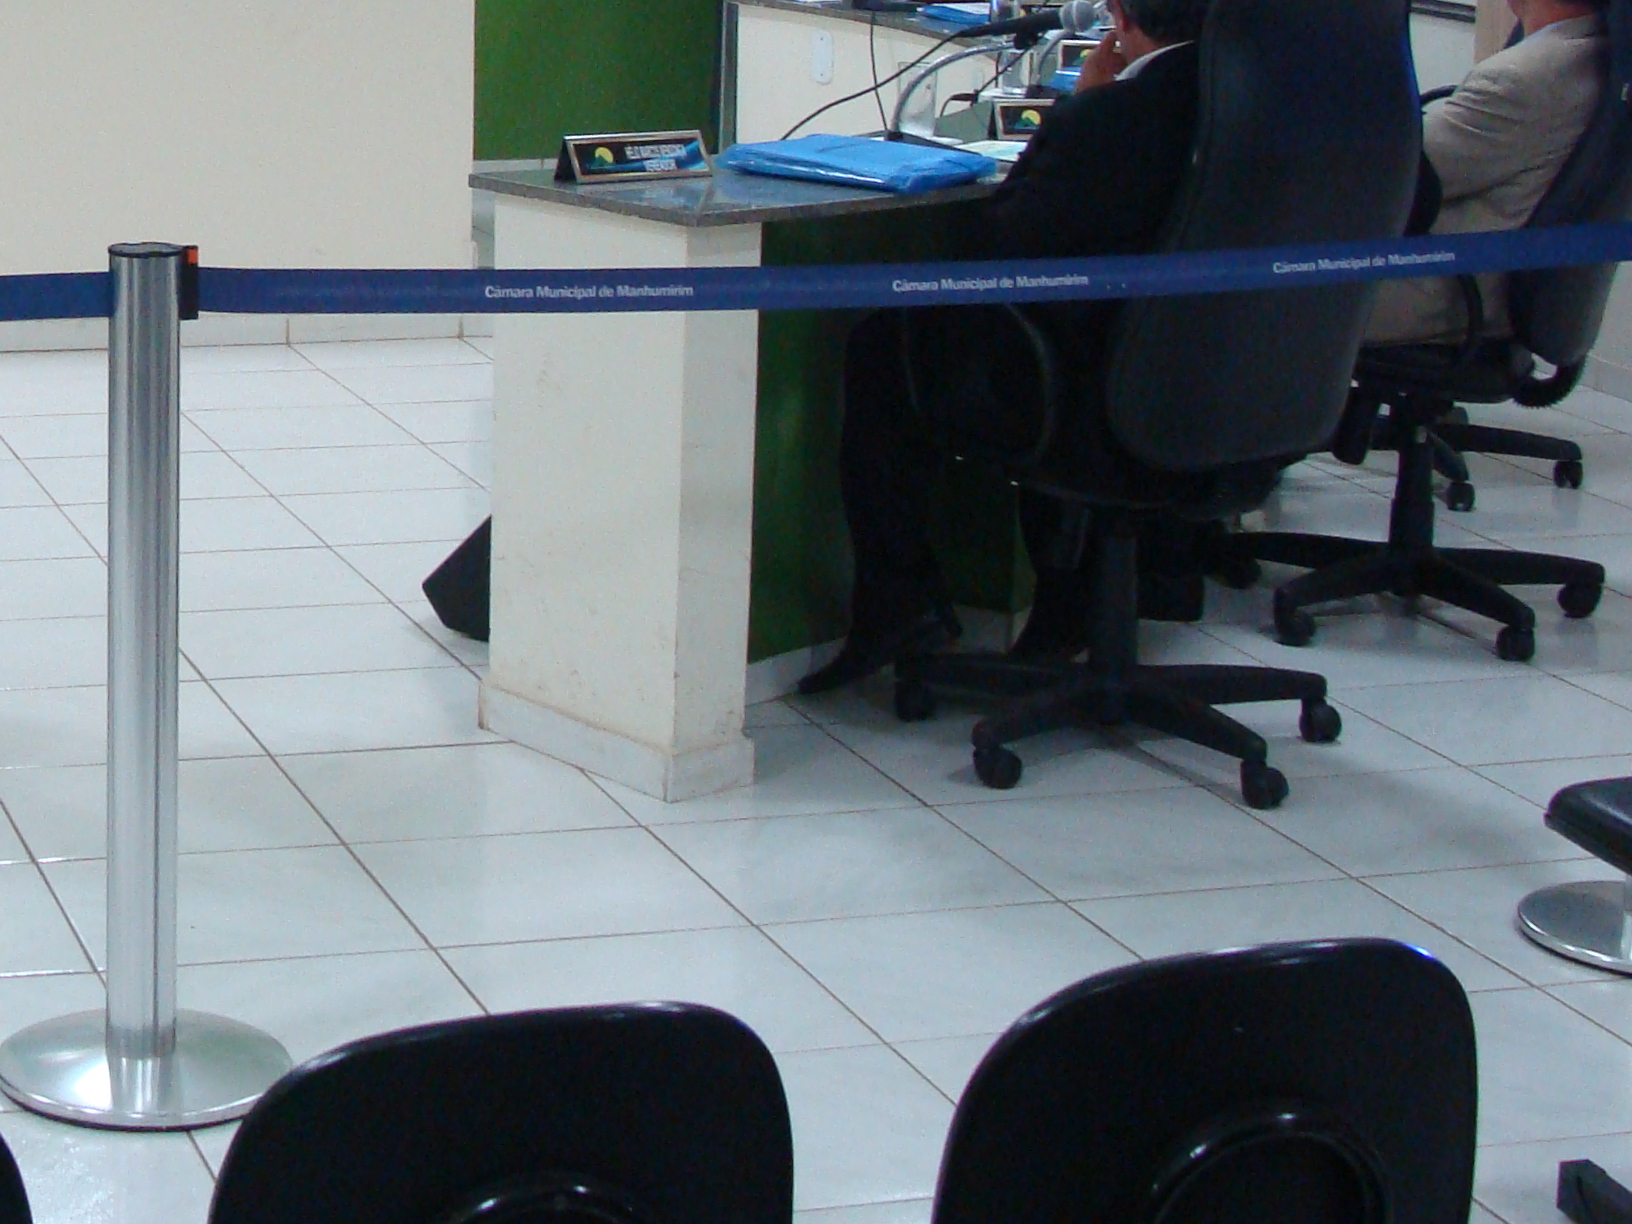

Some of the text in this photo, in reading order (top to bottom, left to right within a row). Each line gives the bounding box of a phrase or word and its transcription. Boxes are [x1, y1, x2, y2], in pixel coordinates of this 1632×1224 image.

[484, 283, 694, 300] Câmara Municipal de Manhumirim
[940, 276, 998, 291] Municipal
[999, 277, 1015, 288] de
